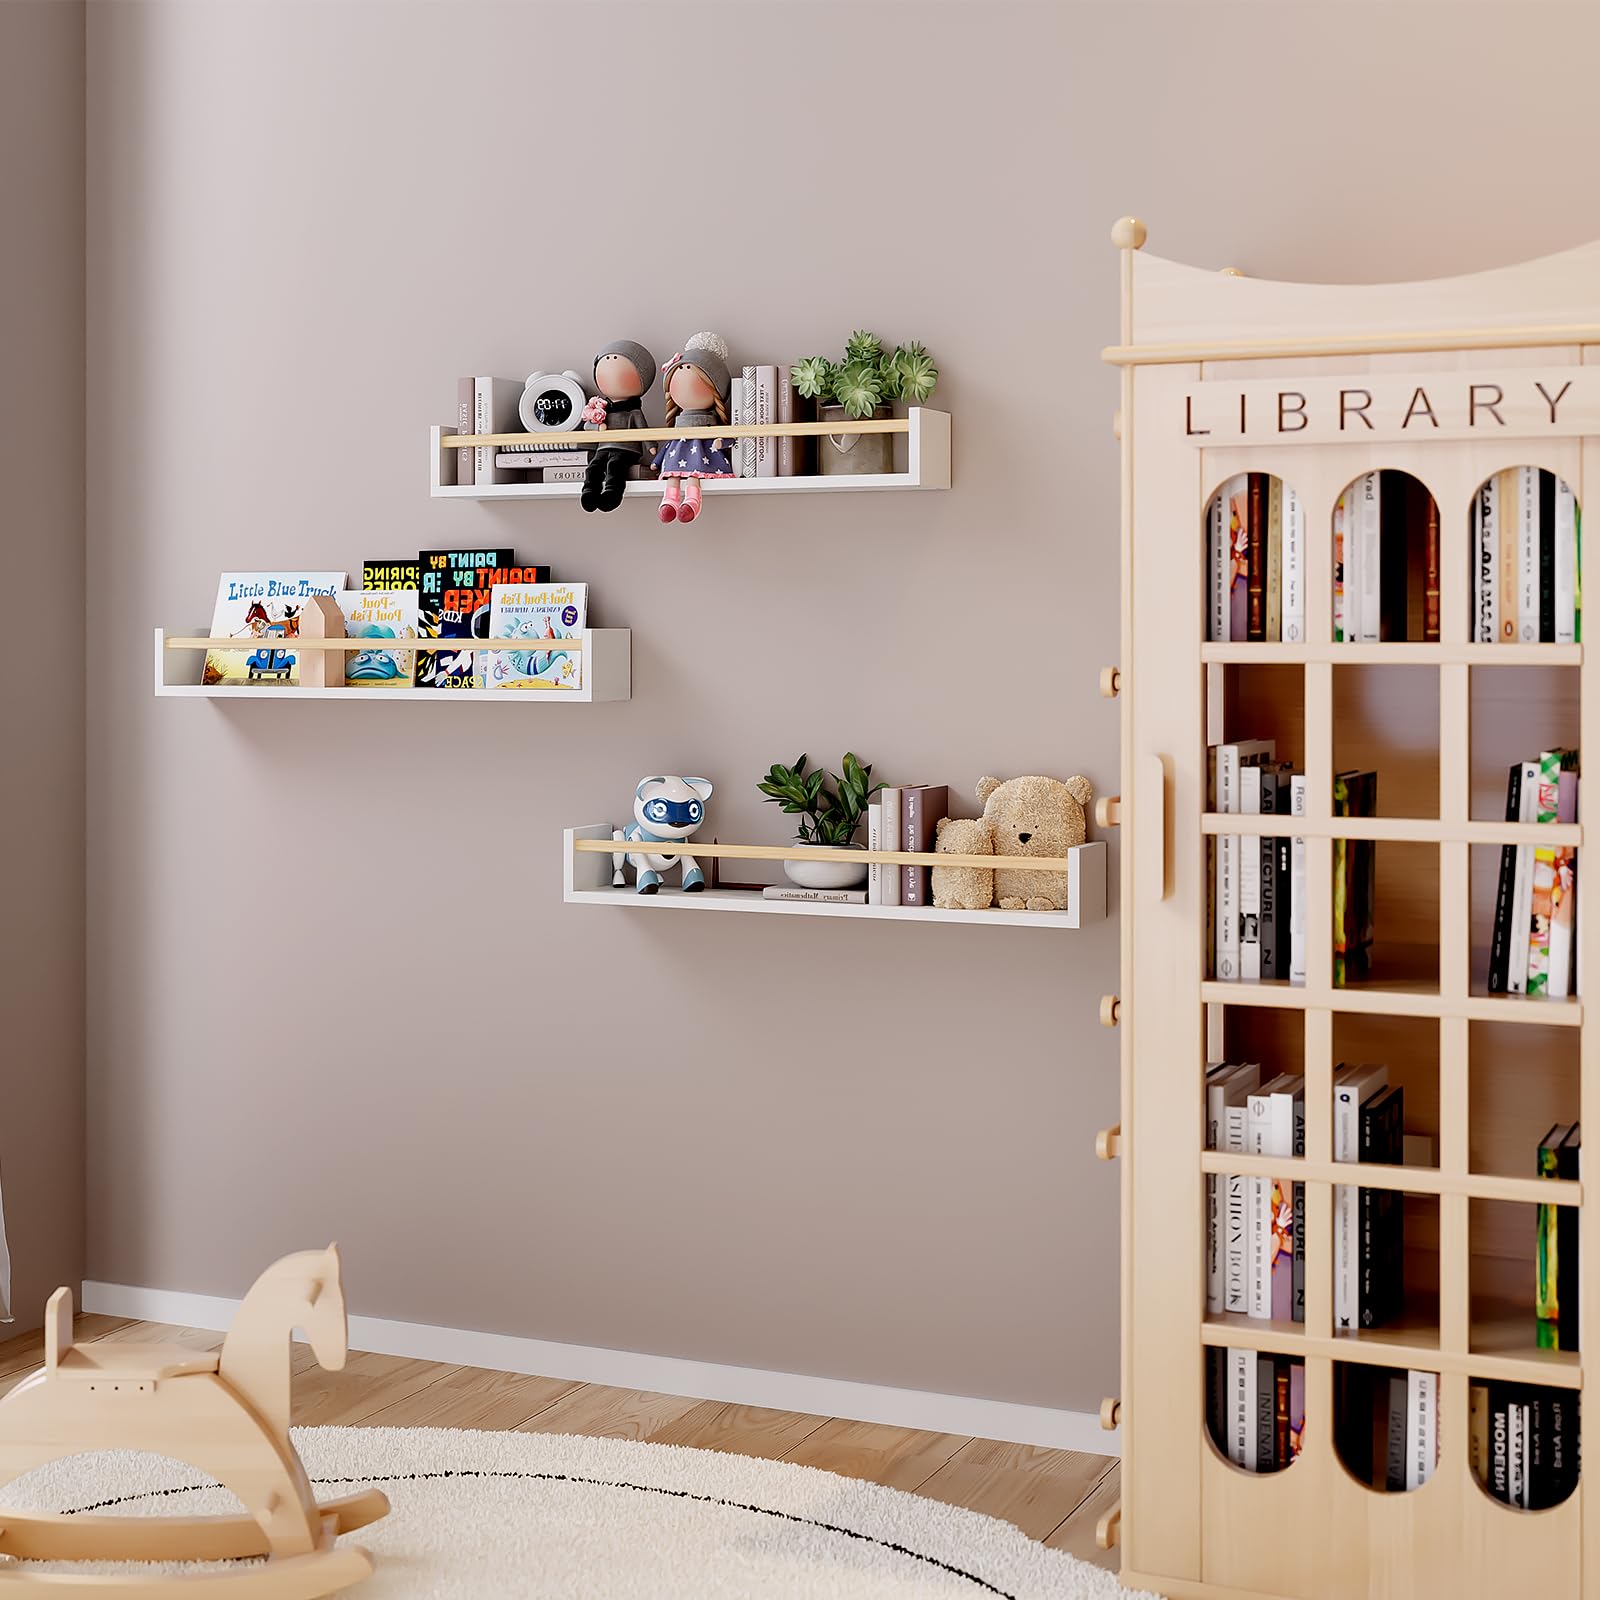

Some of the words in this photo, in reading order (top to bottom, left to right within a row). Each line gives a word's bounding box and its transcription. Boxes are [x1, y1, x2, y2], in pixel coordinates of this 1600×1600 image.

[1186, 381, 1572, 435] LIBRARY
[228, 583, 264, 600] Little
[268, 580, 296, 597] Blue
[299, 580, 337, 599] Truck
[1263, 787, 1273, 923] ARITECTURE
[1230, 1174, 1242, 1243] ASHION
[1296, 1115, 1305, 1262] ARCECTURE
[1230, 1250, 1242, 1306] BOOK
